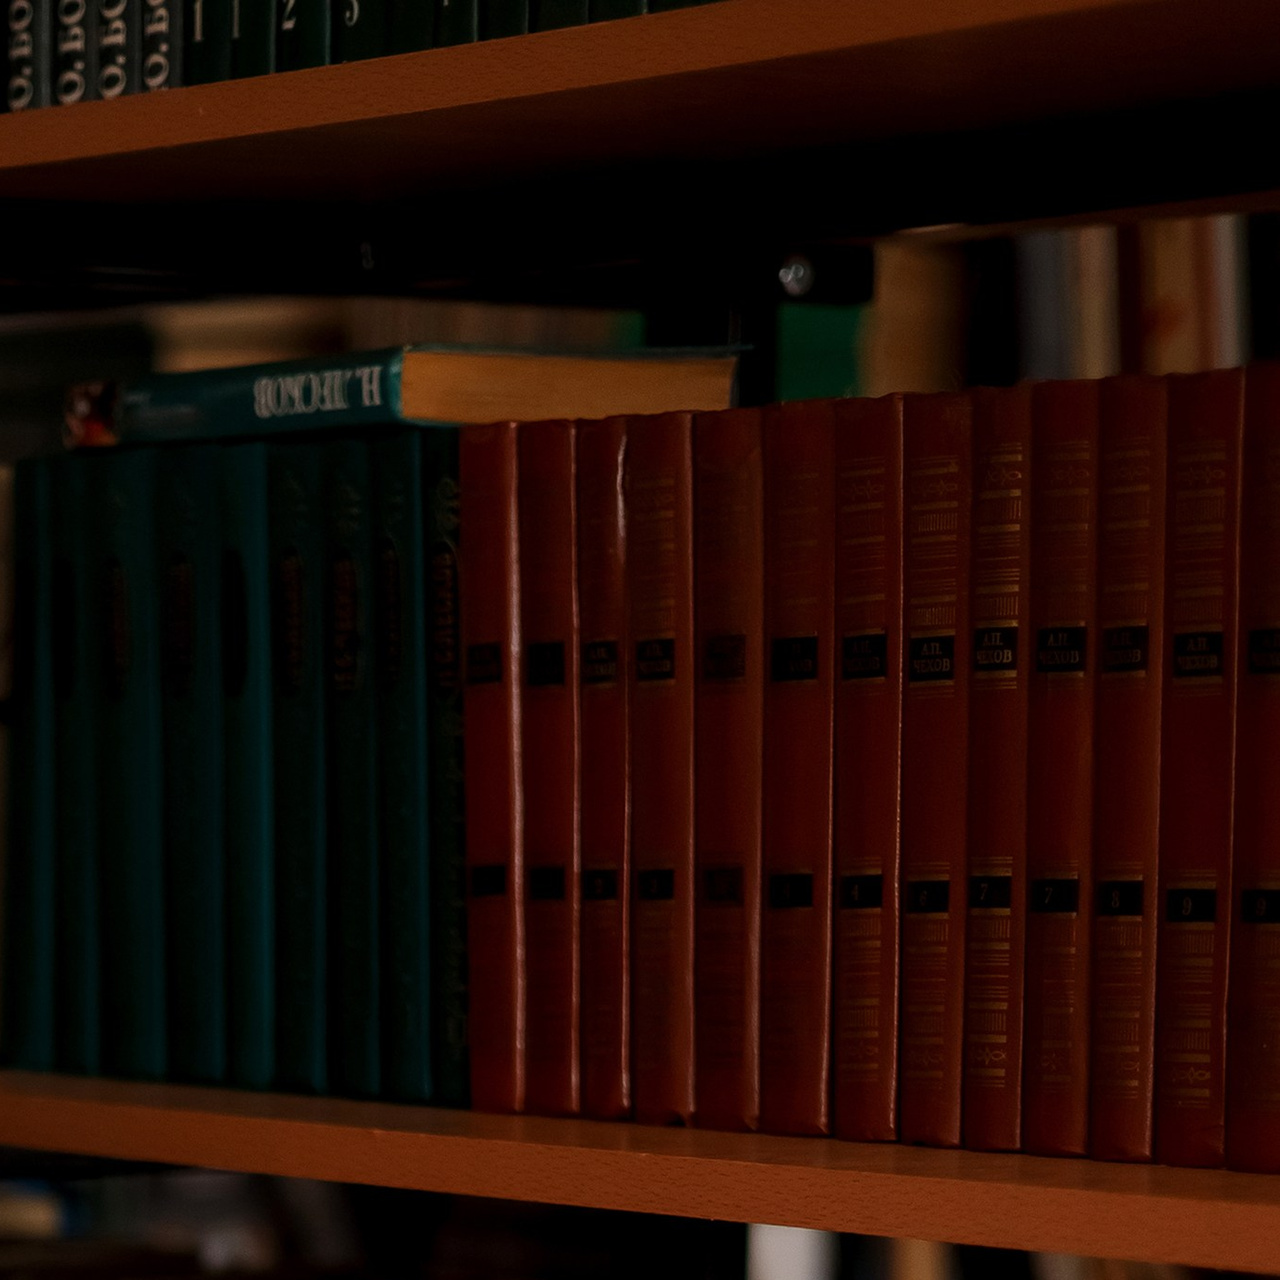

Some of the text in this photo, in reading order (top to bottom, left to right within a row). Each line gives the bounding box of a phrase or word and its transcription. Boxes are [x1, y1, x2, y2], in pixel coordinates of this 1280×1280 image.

[912, 657, 951, 674] ЧЕХОВ
[976, 649, 1013, 665] ЧЕХОВ
[1038, 649, 1080, 666] ЧЕХОВ
[978, 882, 989, 901] 7
[1044, 886, 1054, 905] 7
[1111, 889, 1120, 909] 8
[1181, 896, 1193, 916] 9
